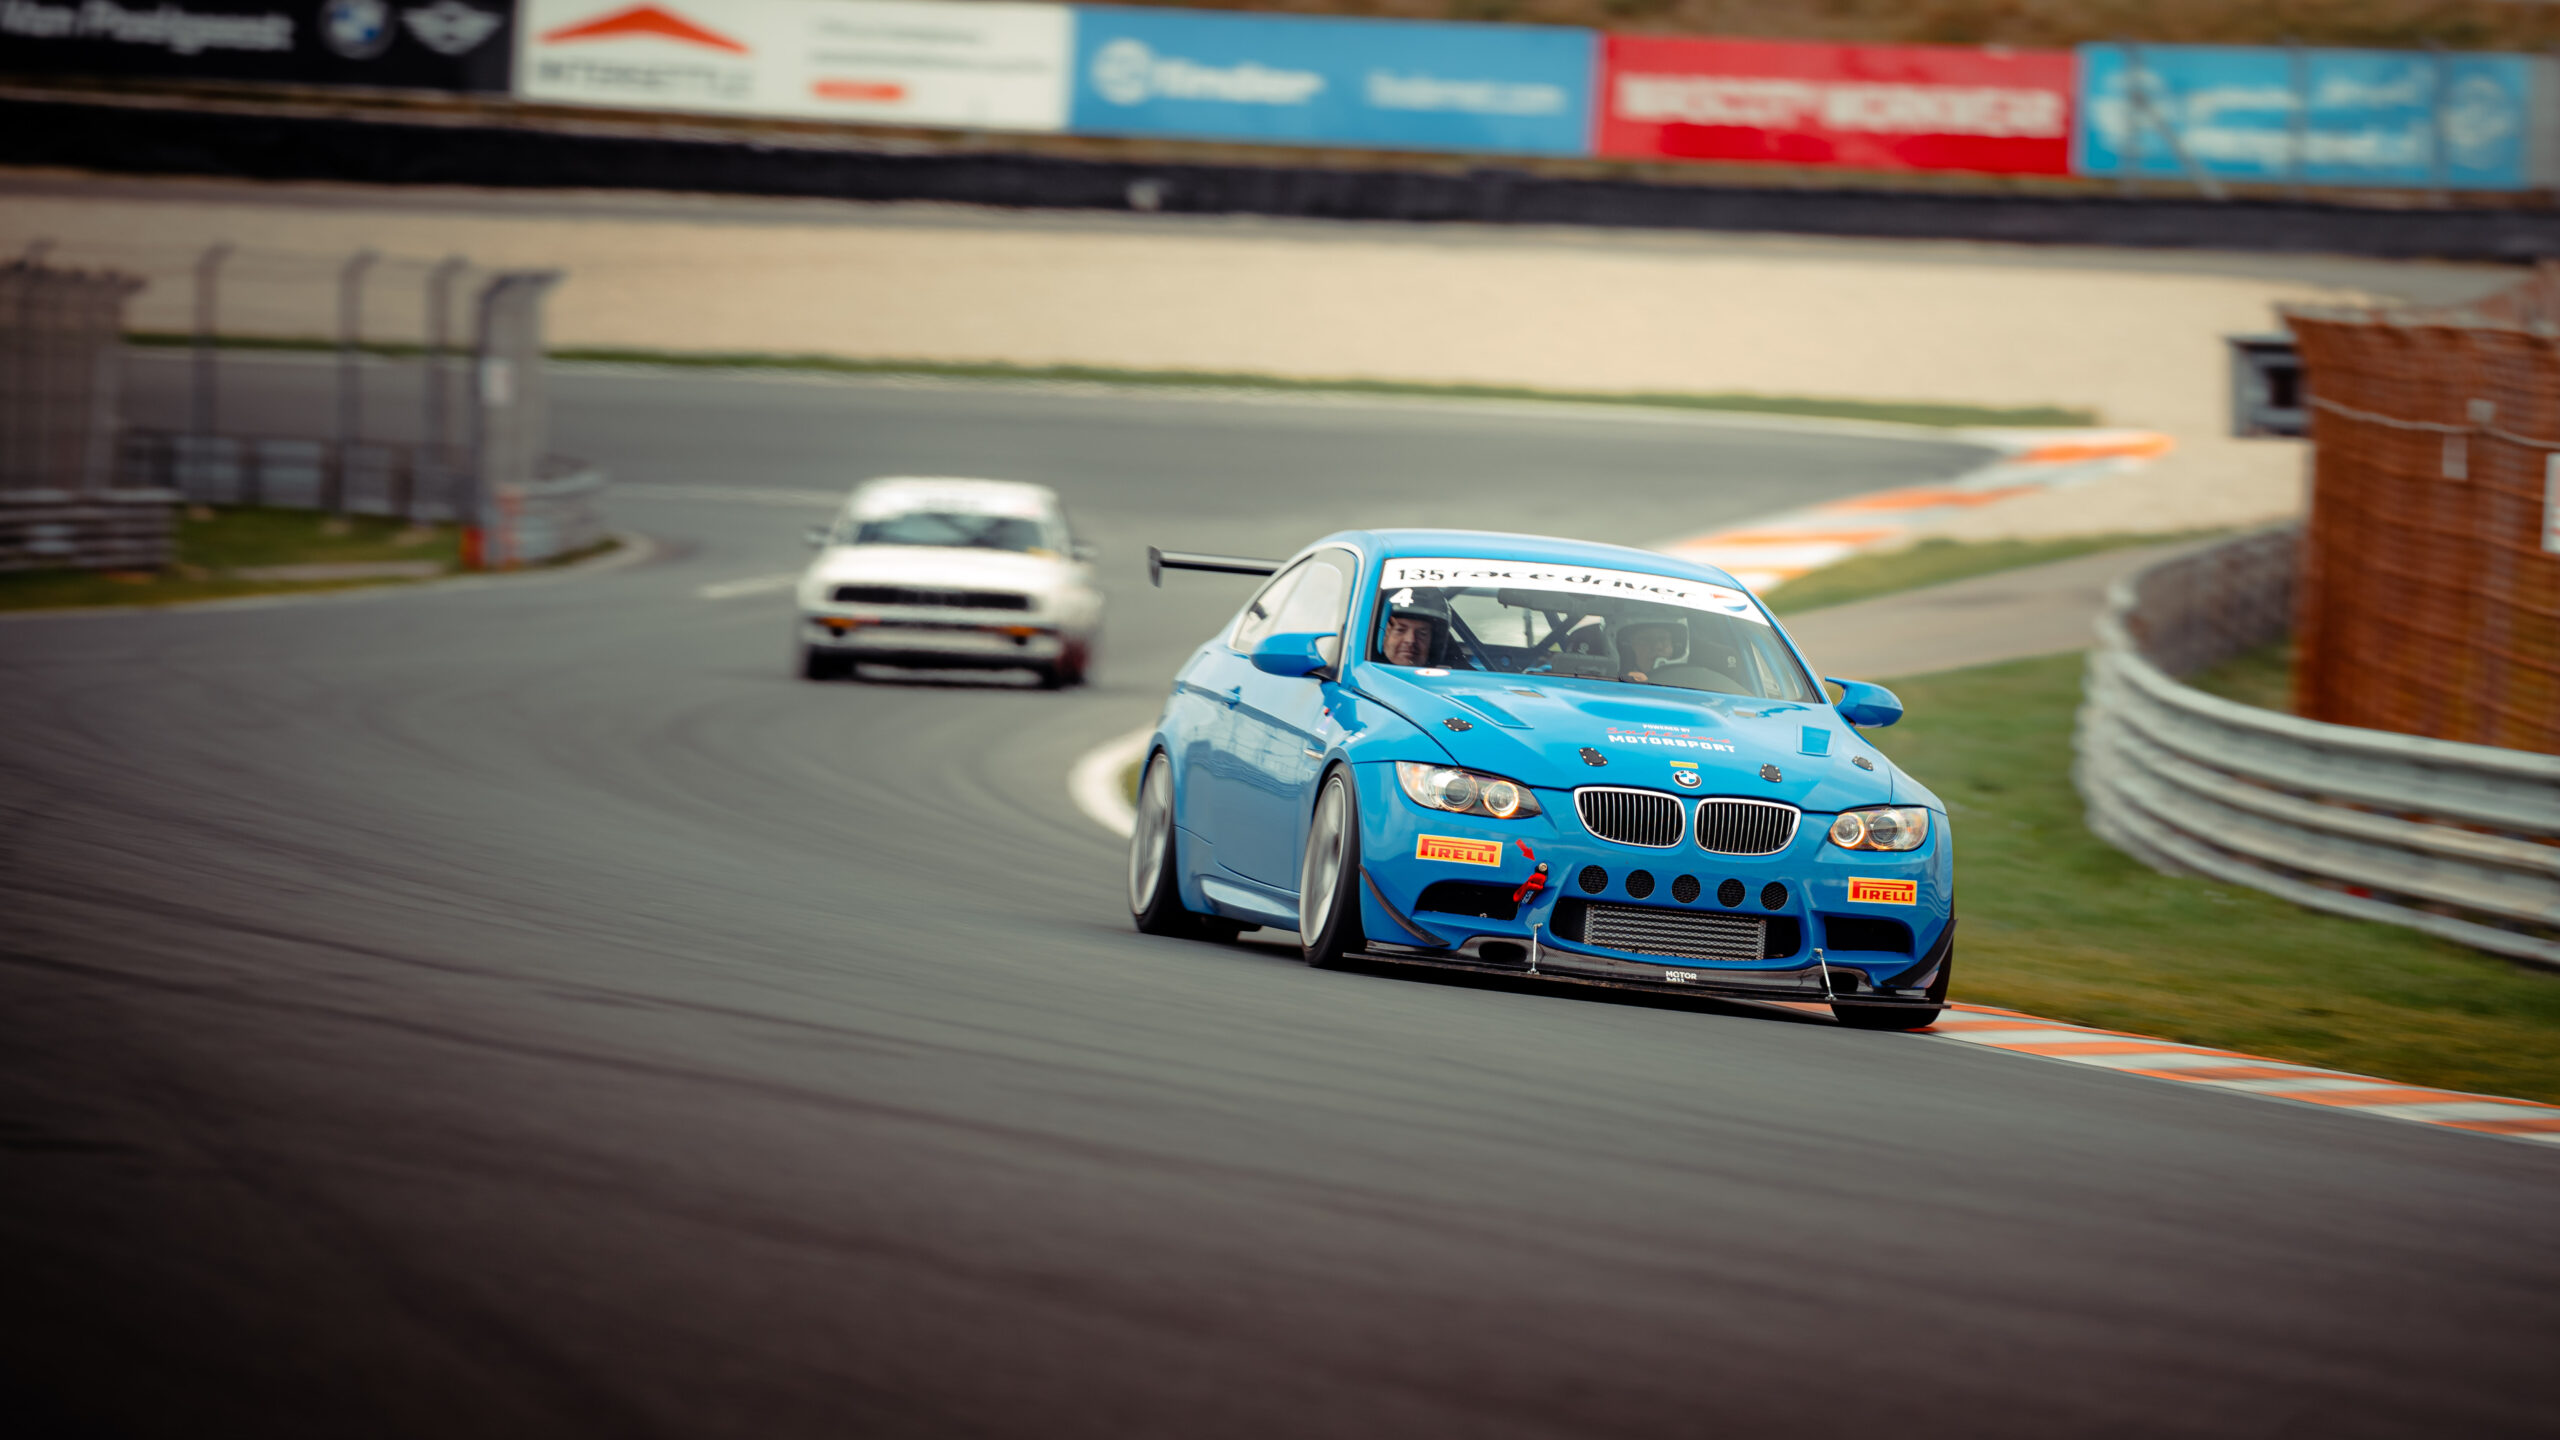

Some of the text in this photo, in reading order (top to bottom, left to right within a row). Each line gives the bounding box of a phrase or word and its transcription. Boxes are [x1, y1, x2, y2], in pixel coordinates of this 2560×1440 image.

[1398, 569, 1696, 599] 135 race driver
[1389, 588, 1414, 608] 4
[1607, 734, 1735, 753] MOTORSPORT
[1420, 838, 1497, 863] PIRELLI
[1852, 881, 1914, 902] PIRELLI
[1665, 970, 1698, 980] MOTOR
